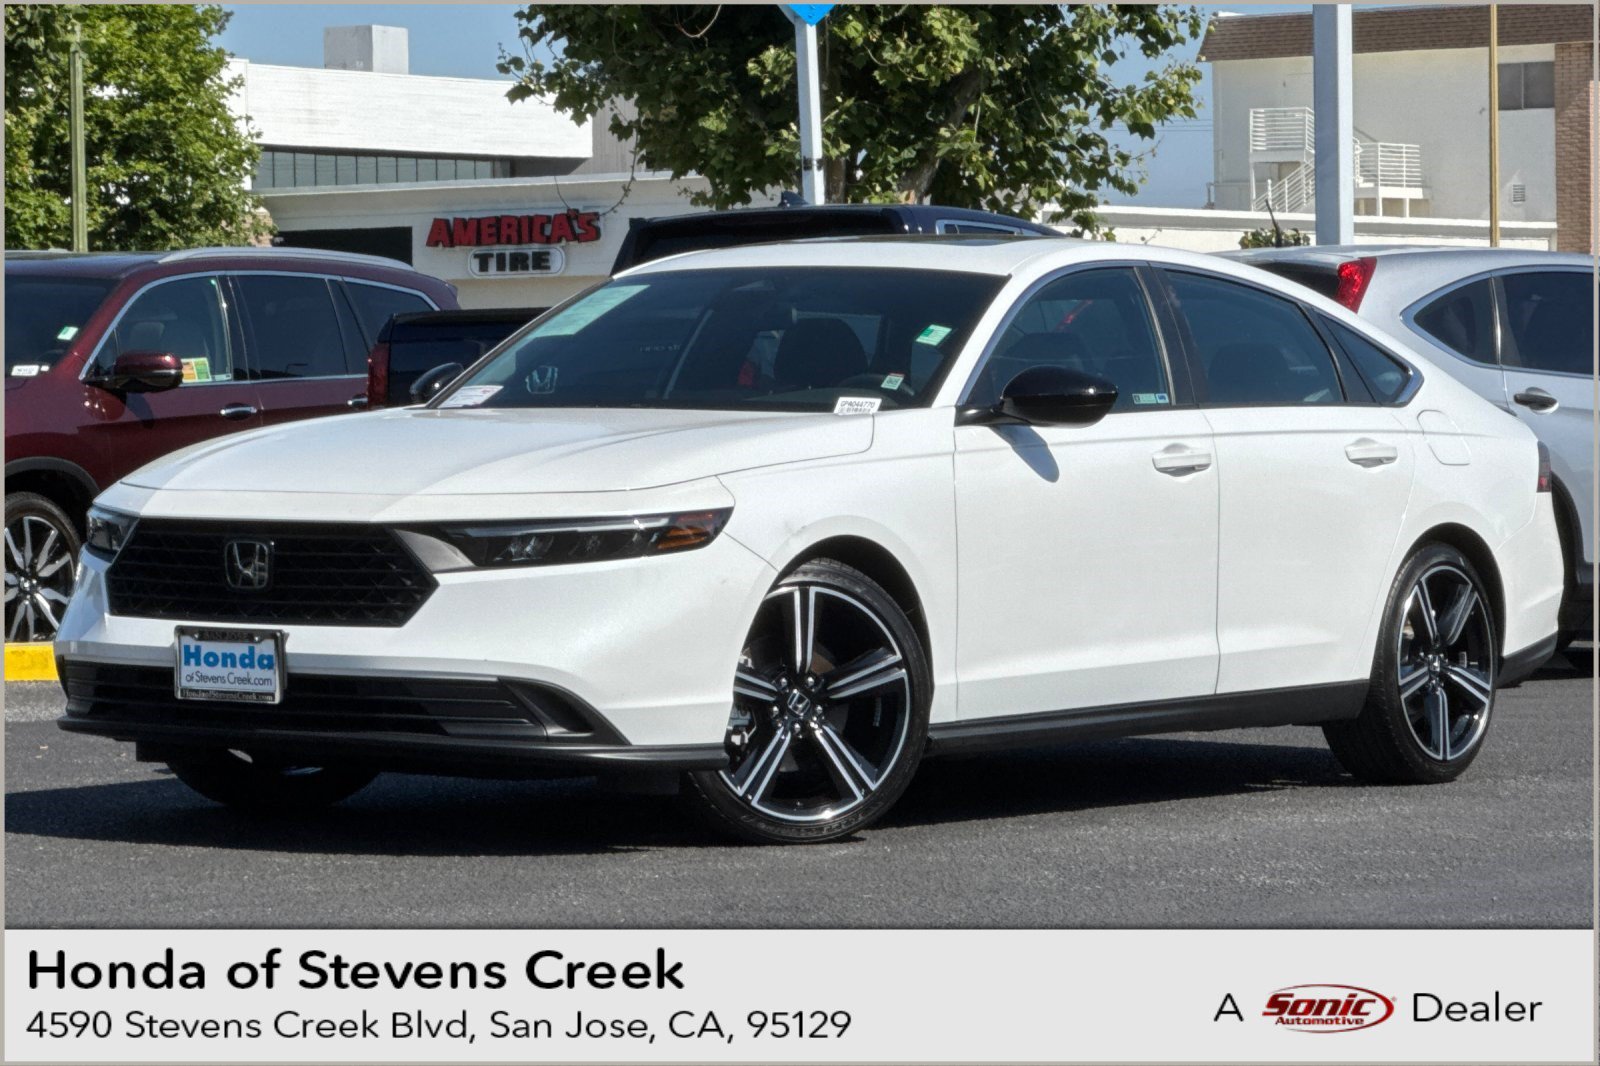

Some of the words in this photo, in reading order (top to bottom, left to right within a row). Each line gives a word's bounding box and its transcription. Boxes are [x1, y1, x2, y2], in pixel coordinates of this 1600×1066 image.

[426, 209, 601, 247] AMERICA'S
[473, 251, 551, 272] TIRE
[183, 644, 275, 670] Honda
[185, 673, 194, 682] of
[195, 670, 226, 684] Stevens
[227, 672, 272, 686] Creek.com
